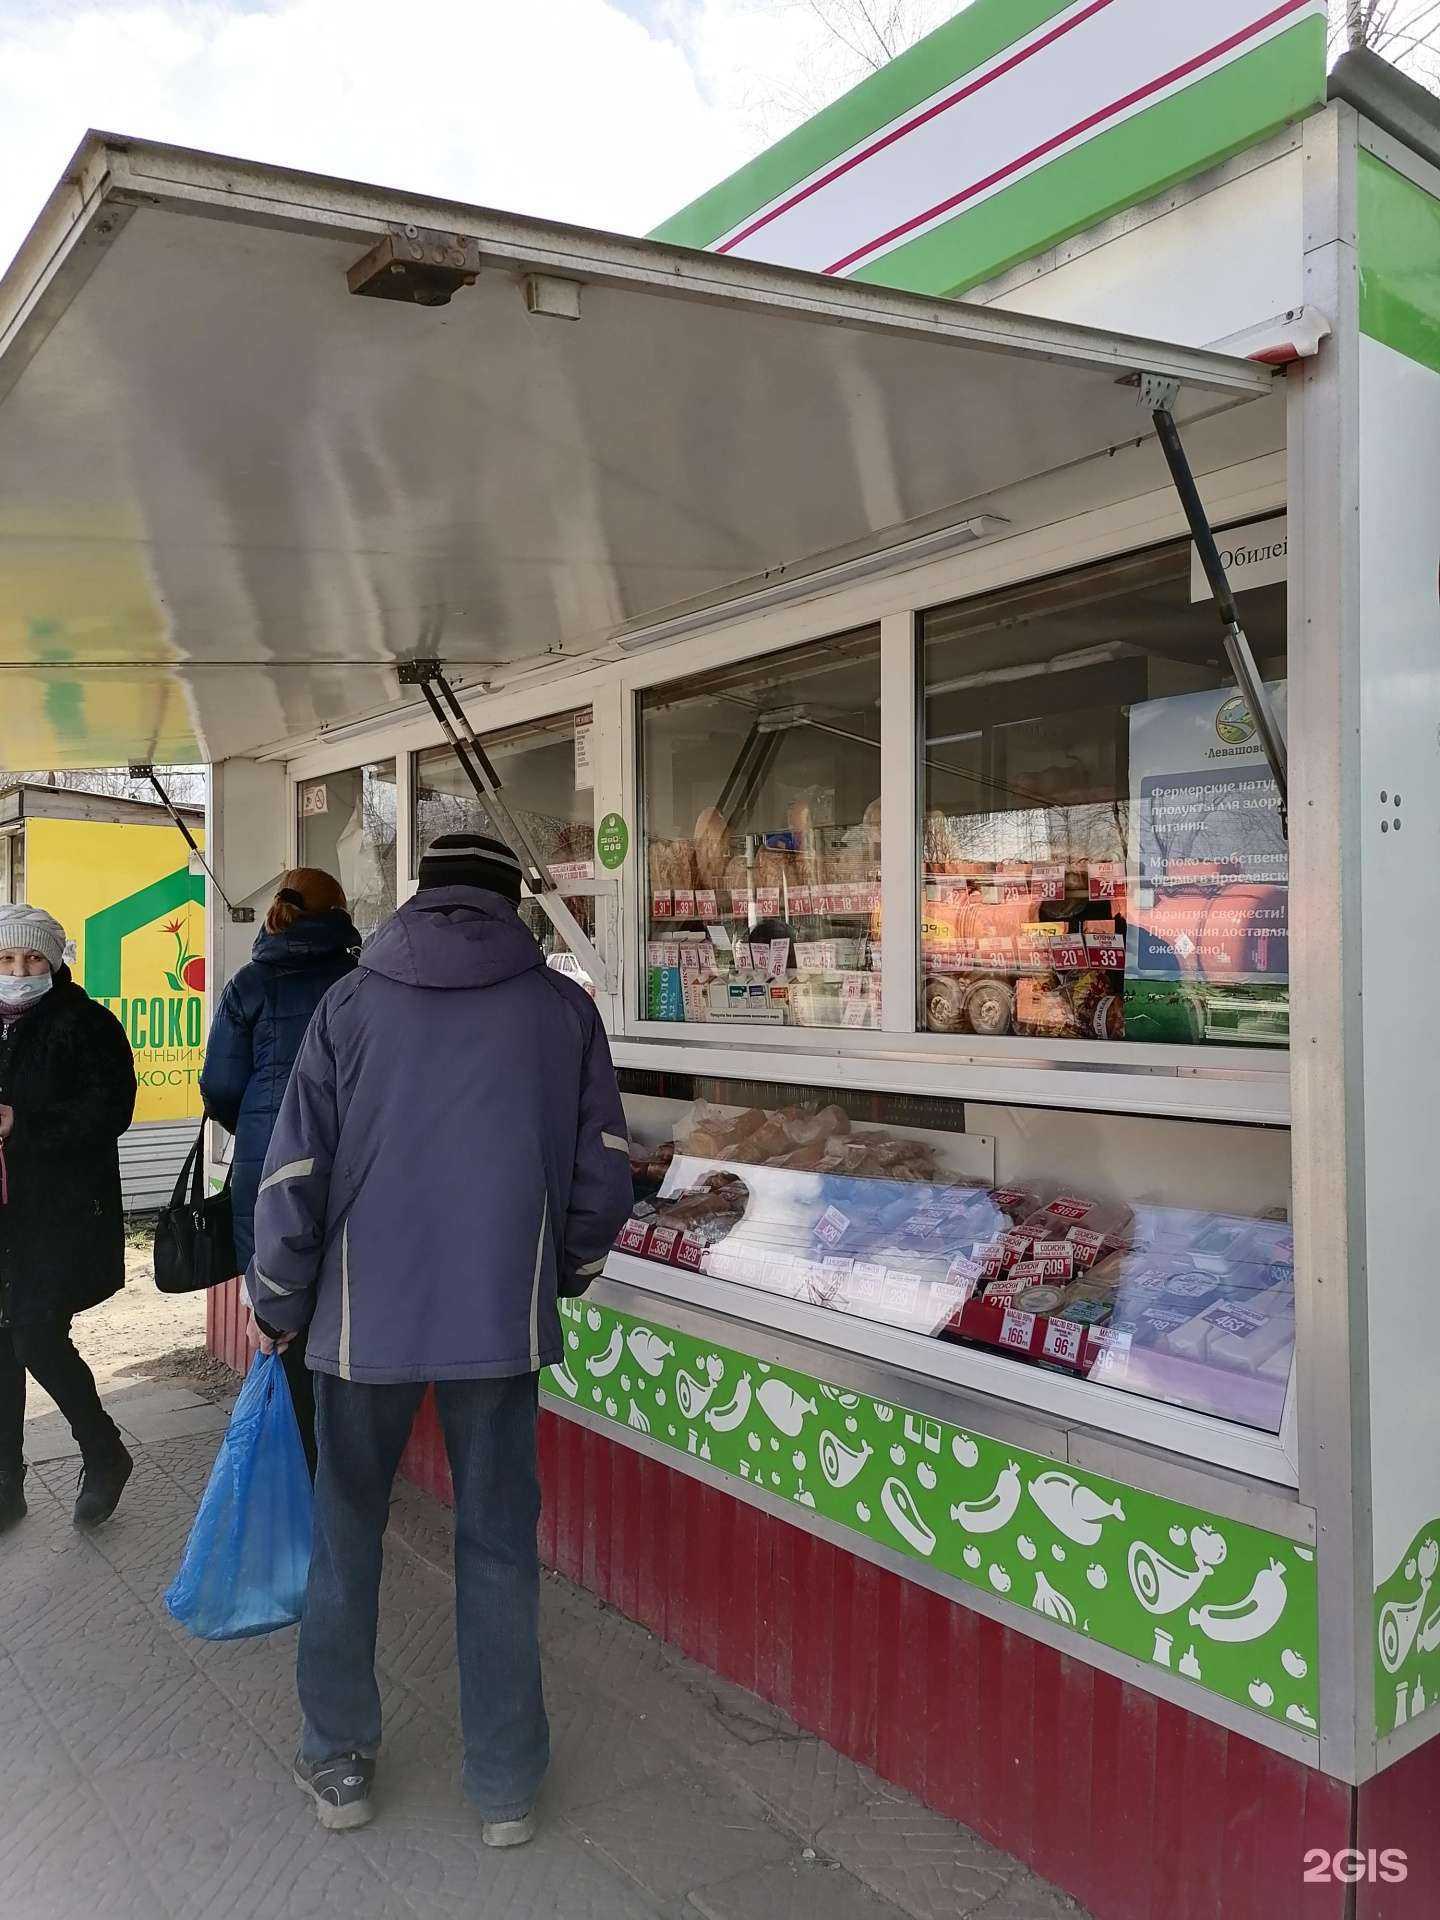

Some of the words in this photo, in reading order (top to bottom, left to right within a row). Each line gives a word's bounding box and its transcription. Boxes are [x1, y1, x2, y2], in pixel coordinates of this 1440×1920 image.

[1151, 781, 1236, 799] Фермерские
[1151, 801, 1215, 819] продукты
[1217, 801, 1240, 811] для
[1150, 857, 1199, 868] Молоко
[1041, 882, 1056, 898] 38
[1099, 880, 1115, 896] 24
[1212, 905, 1285, 920] свежести!
[1061, 950, 1078, 966] 20
[1100, 950, 1117, 966] 33
[1040, 1244, 1066, 1252] СОСИСКИ
[1044, 1259, 1064, 1275] 309
[1007, 1326, 1023, 1345] 166
[1053, 1337, 1069, 1356] 96
